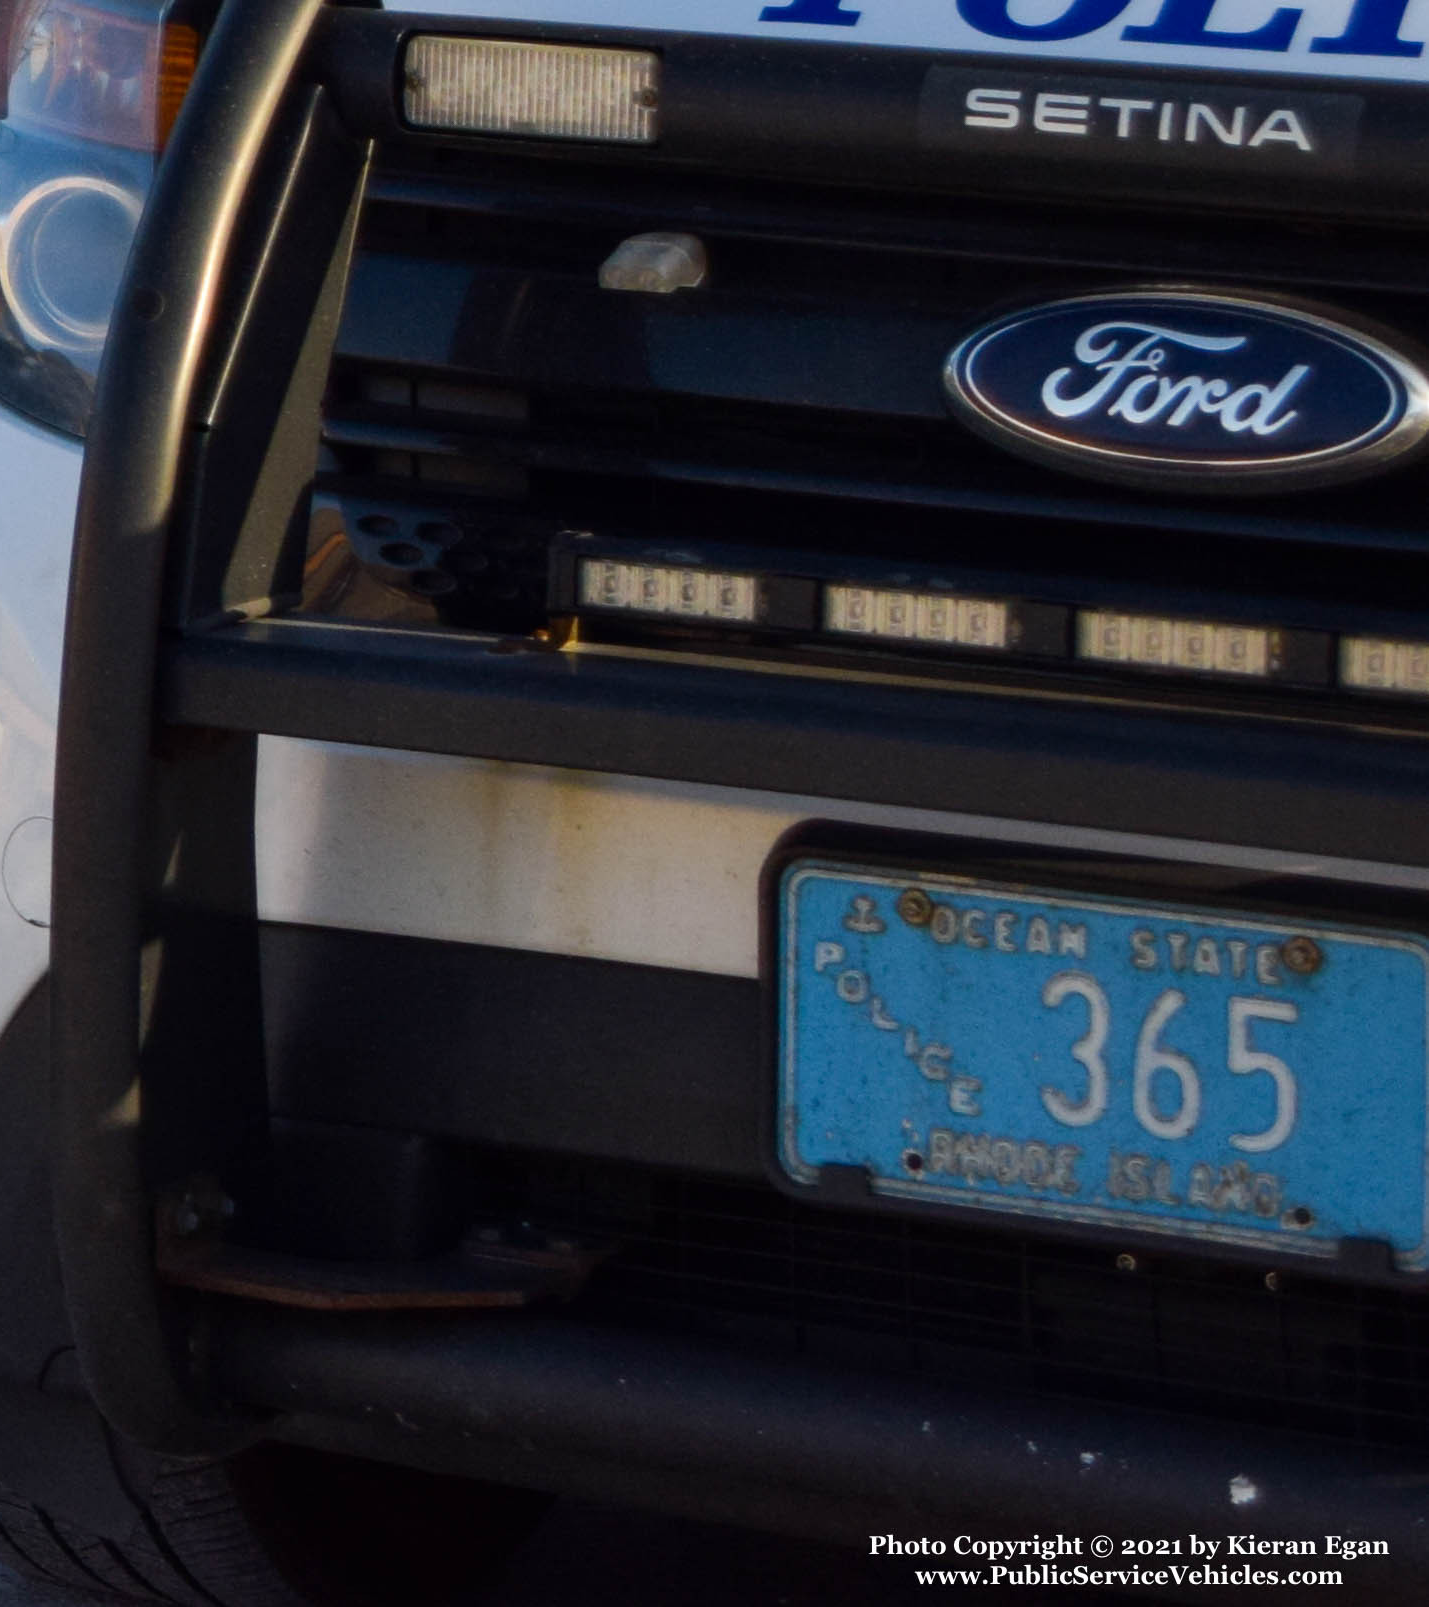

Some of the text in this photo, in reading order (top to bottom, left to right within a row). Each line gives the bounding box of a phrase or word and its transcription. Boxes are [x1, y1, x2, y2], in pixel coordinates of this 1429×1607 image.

[964, 88, 1313, 152] SETINA
[1041, 322, 1310, 436] Ford
[930, 901, 1284, 987] OCEAN STATE
[815, 941, 982, 1116] POLICE
[1040, 970, 1300, 1153] 365
